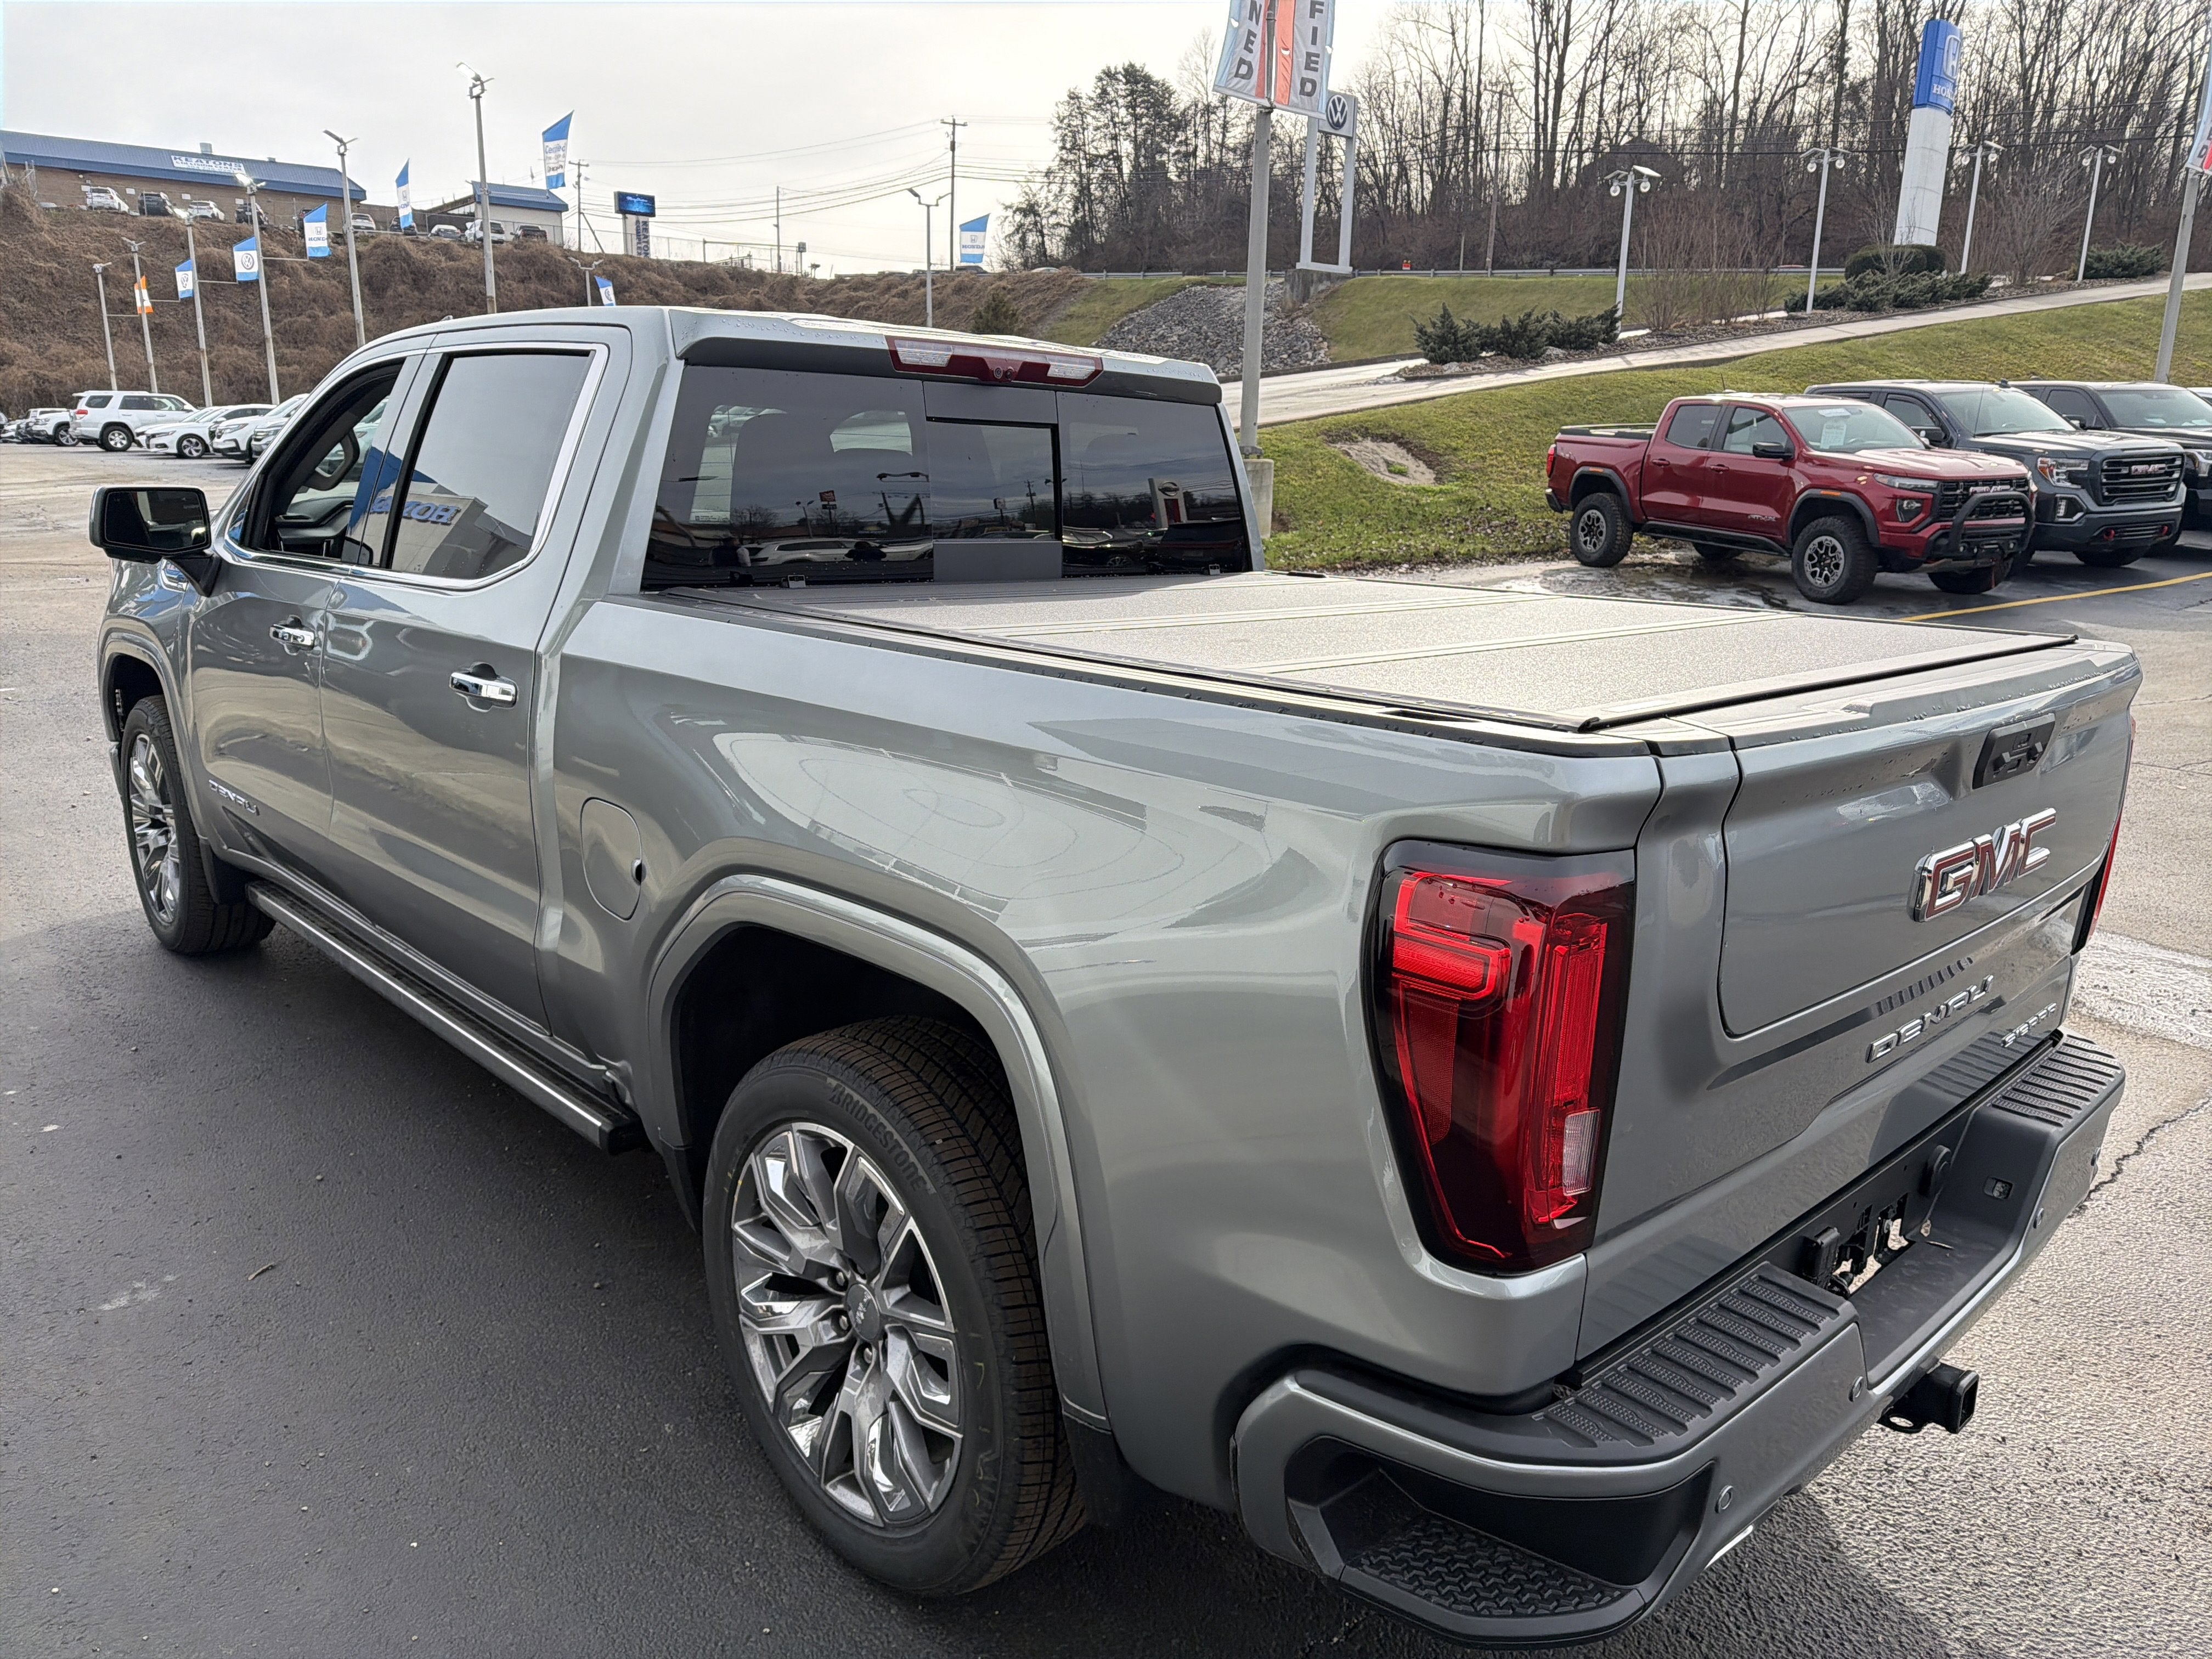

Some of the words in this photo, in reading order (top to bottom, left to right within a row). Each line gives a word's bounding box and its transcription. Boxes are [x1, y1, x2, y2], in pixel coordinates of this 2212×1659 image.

[173, 156, 242, 168] KEATONS
[1906, 807, 2057, 923] GMC
[1865, 974, 1994, 1064] DENALI
[2001, 1003, 2057, 1048] SIERRA
[829, 1082, 927, 1192] BRIDGESTONE
